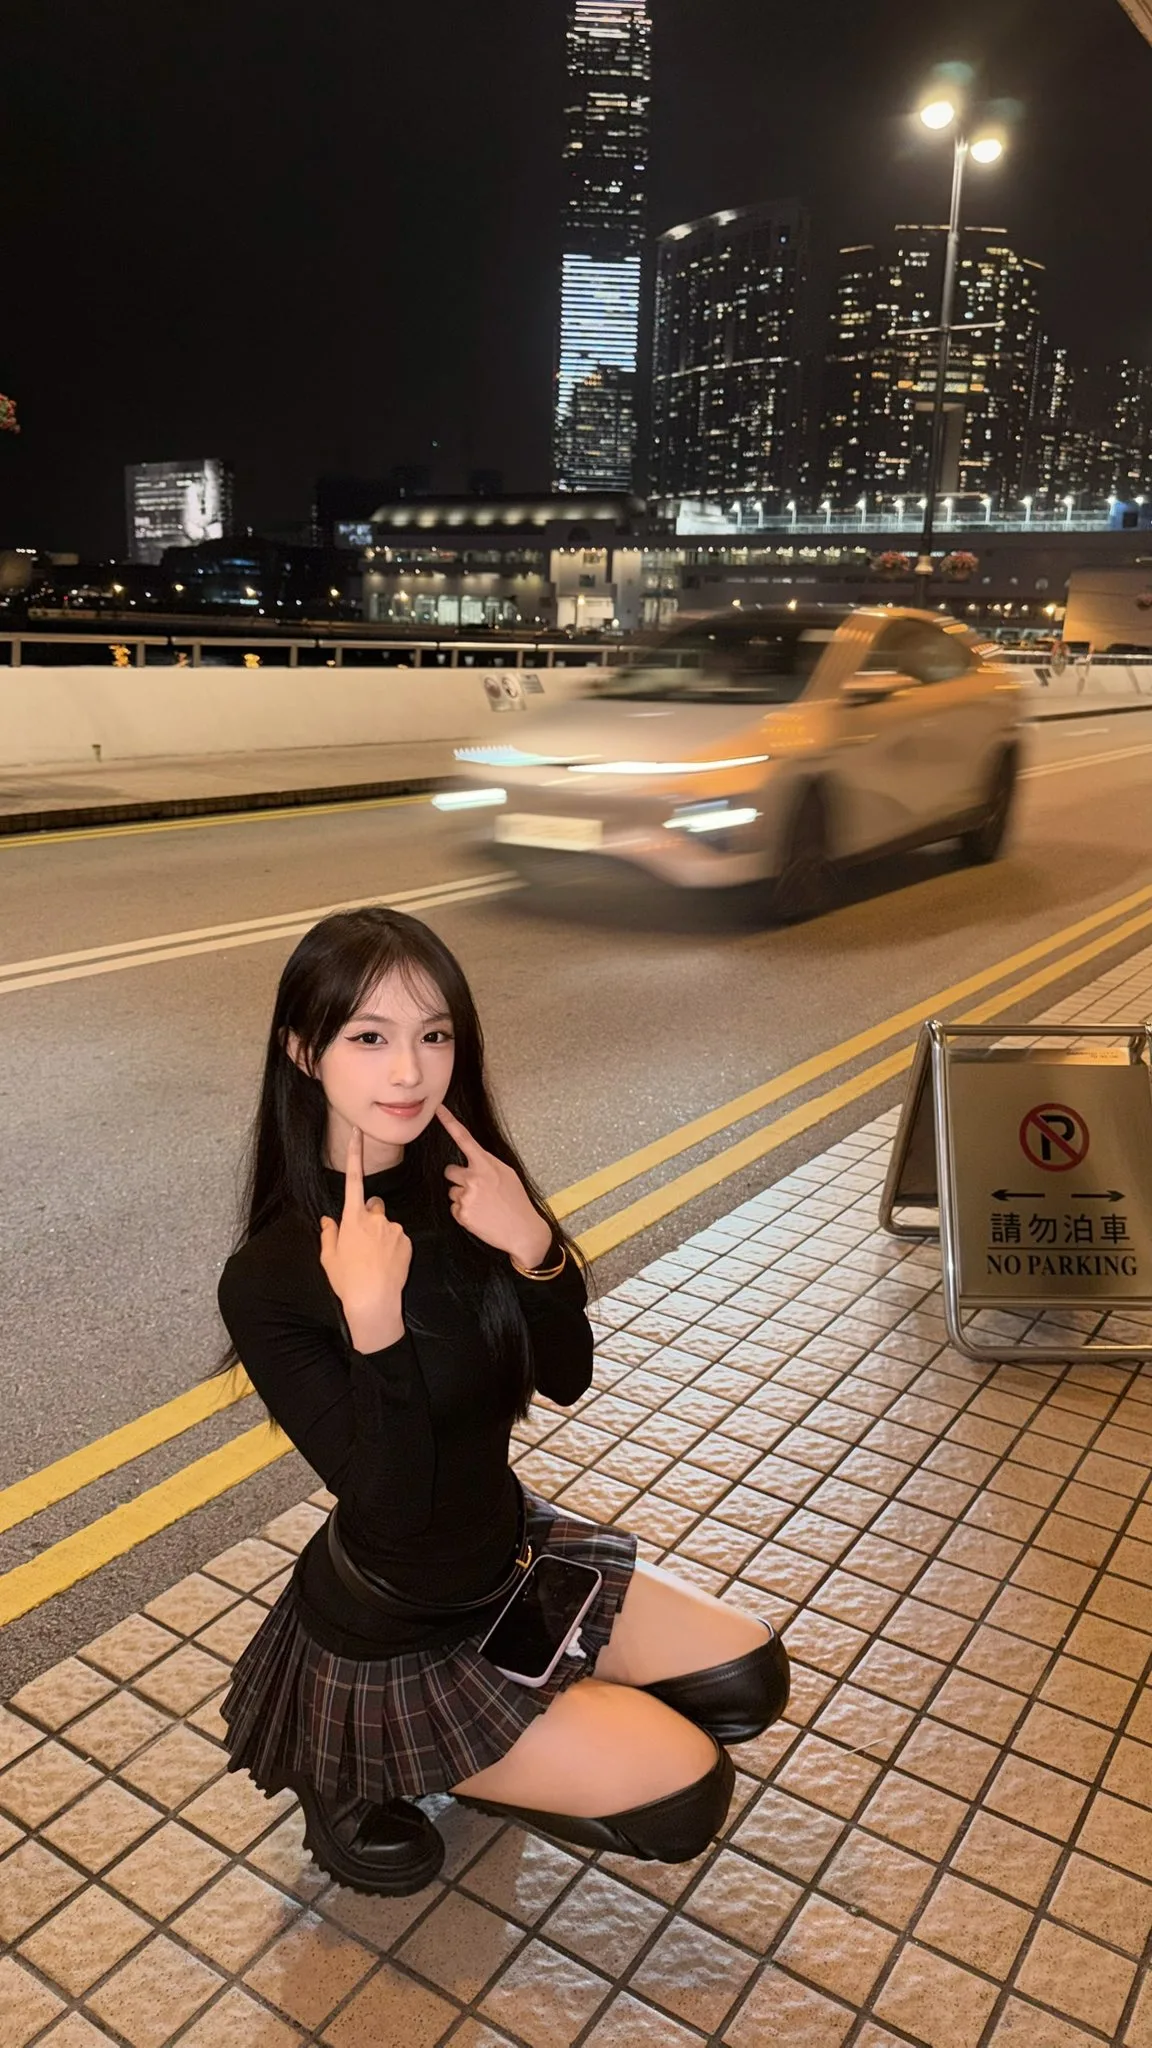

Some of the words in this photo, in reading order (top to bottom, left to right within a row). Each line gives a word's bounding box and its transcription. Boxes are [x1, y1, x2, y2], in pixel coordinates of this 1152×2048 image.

[990, 1212, 1130, 1244] 請勿泊車
[987, 1254, 1021, 1276] NO
[1027, 1254, 1137, 1277] PARKING
